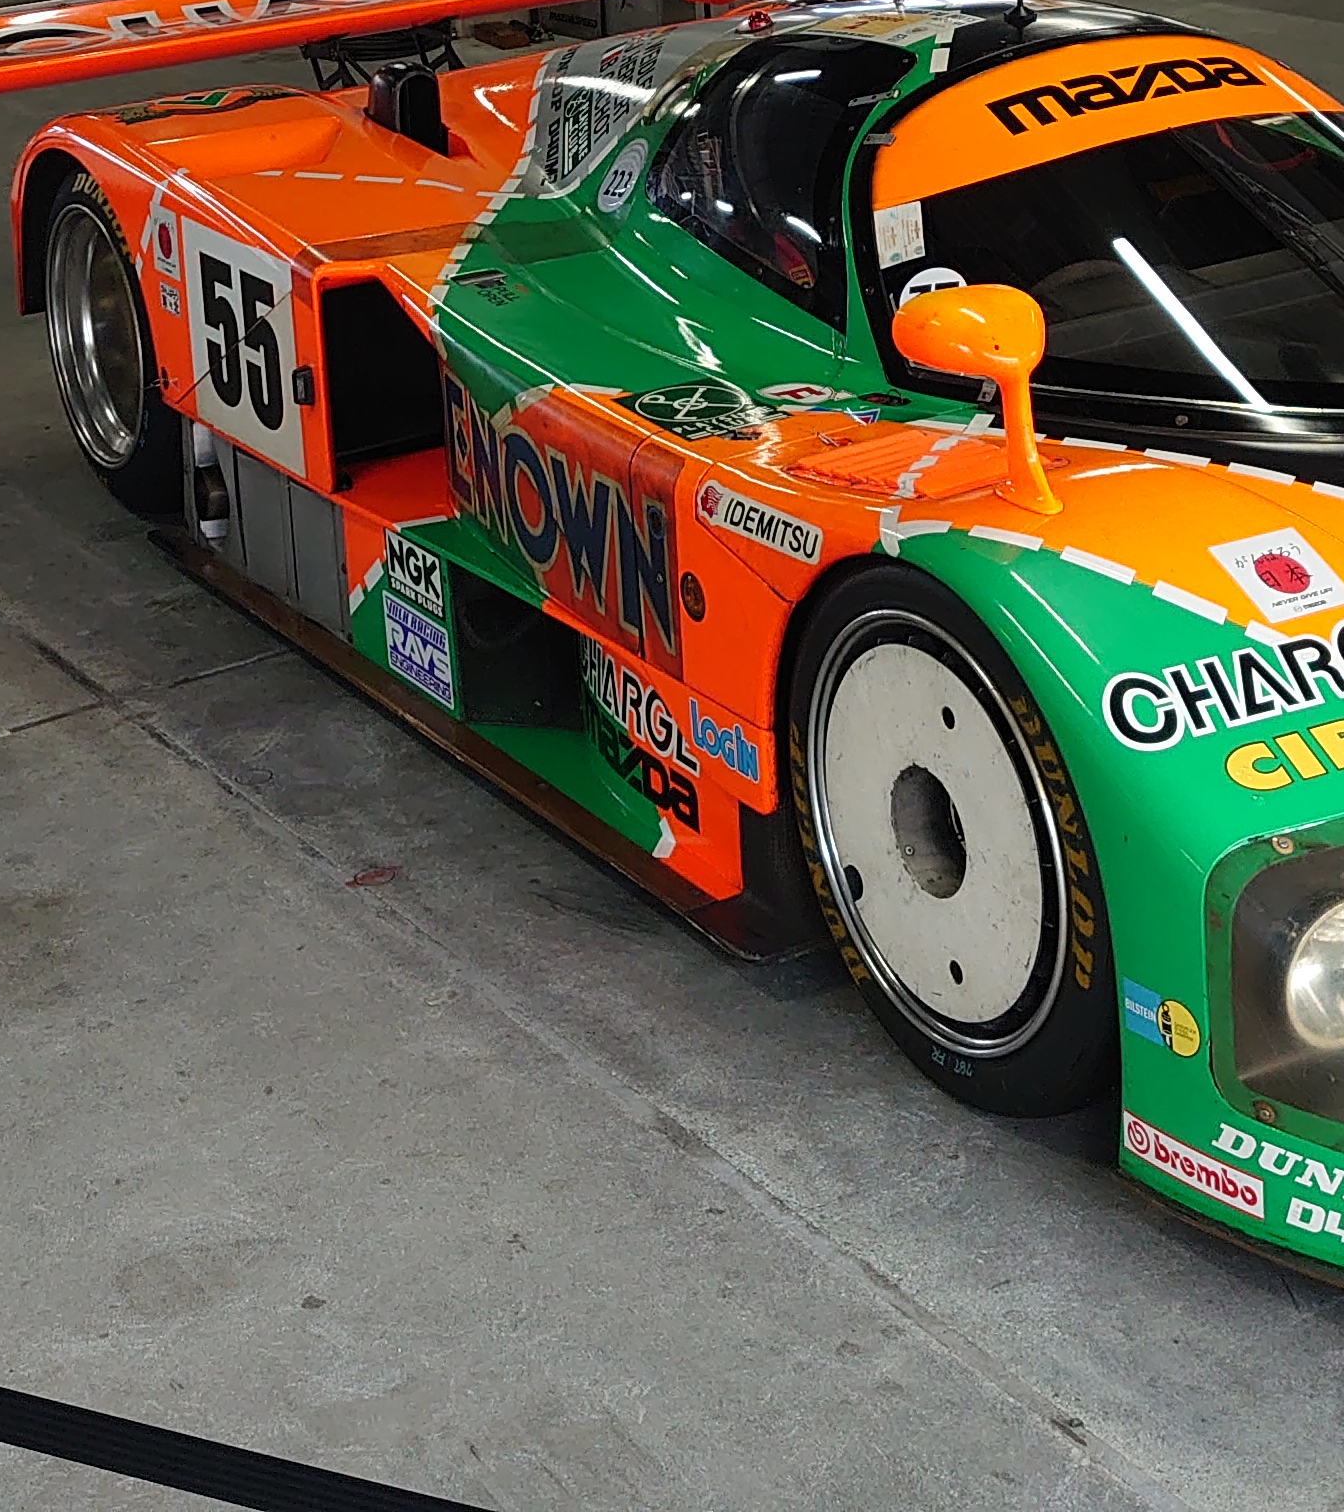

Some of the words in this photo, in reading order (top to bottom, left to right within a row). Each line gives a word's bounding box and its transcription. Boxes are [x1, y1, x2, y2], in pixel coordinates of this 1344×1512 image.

[985, 56, 1267, 136] mazda
[199, 250, 284, 431] 55
[444, 372, 677, 657] ENOWN
[723, 497, 819, 559] IDEMITSU
[387, 533, 441, 600] NGK
[1259, 562, 1314, 589] 日本
[390, 576, 416, 603] SPARK
[417, 592, 444, 619] PLUGS
[1271, 595, 1299, 608] NEVER
[1299, 589, 1319, 600] GIVE
[389, 622, 451, 682] RAYS
[410, 618, 447, 650] RACING
[390, 652, 452, 700] ENGINEERING
[1008, 692, 1096, 990] DUNLOP
[1125, 996, 1157, 1023] BILSTEIN
[1153, 1133, 1259, 1208] brembo
